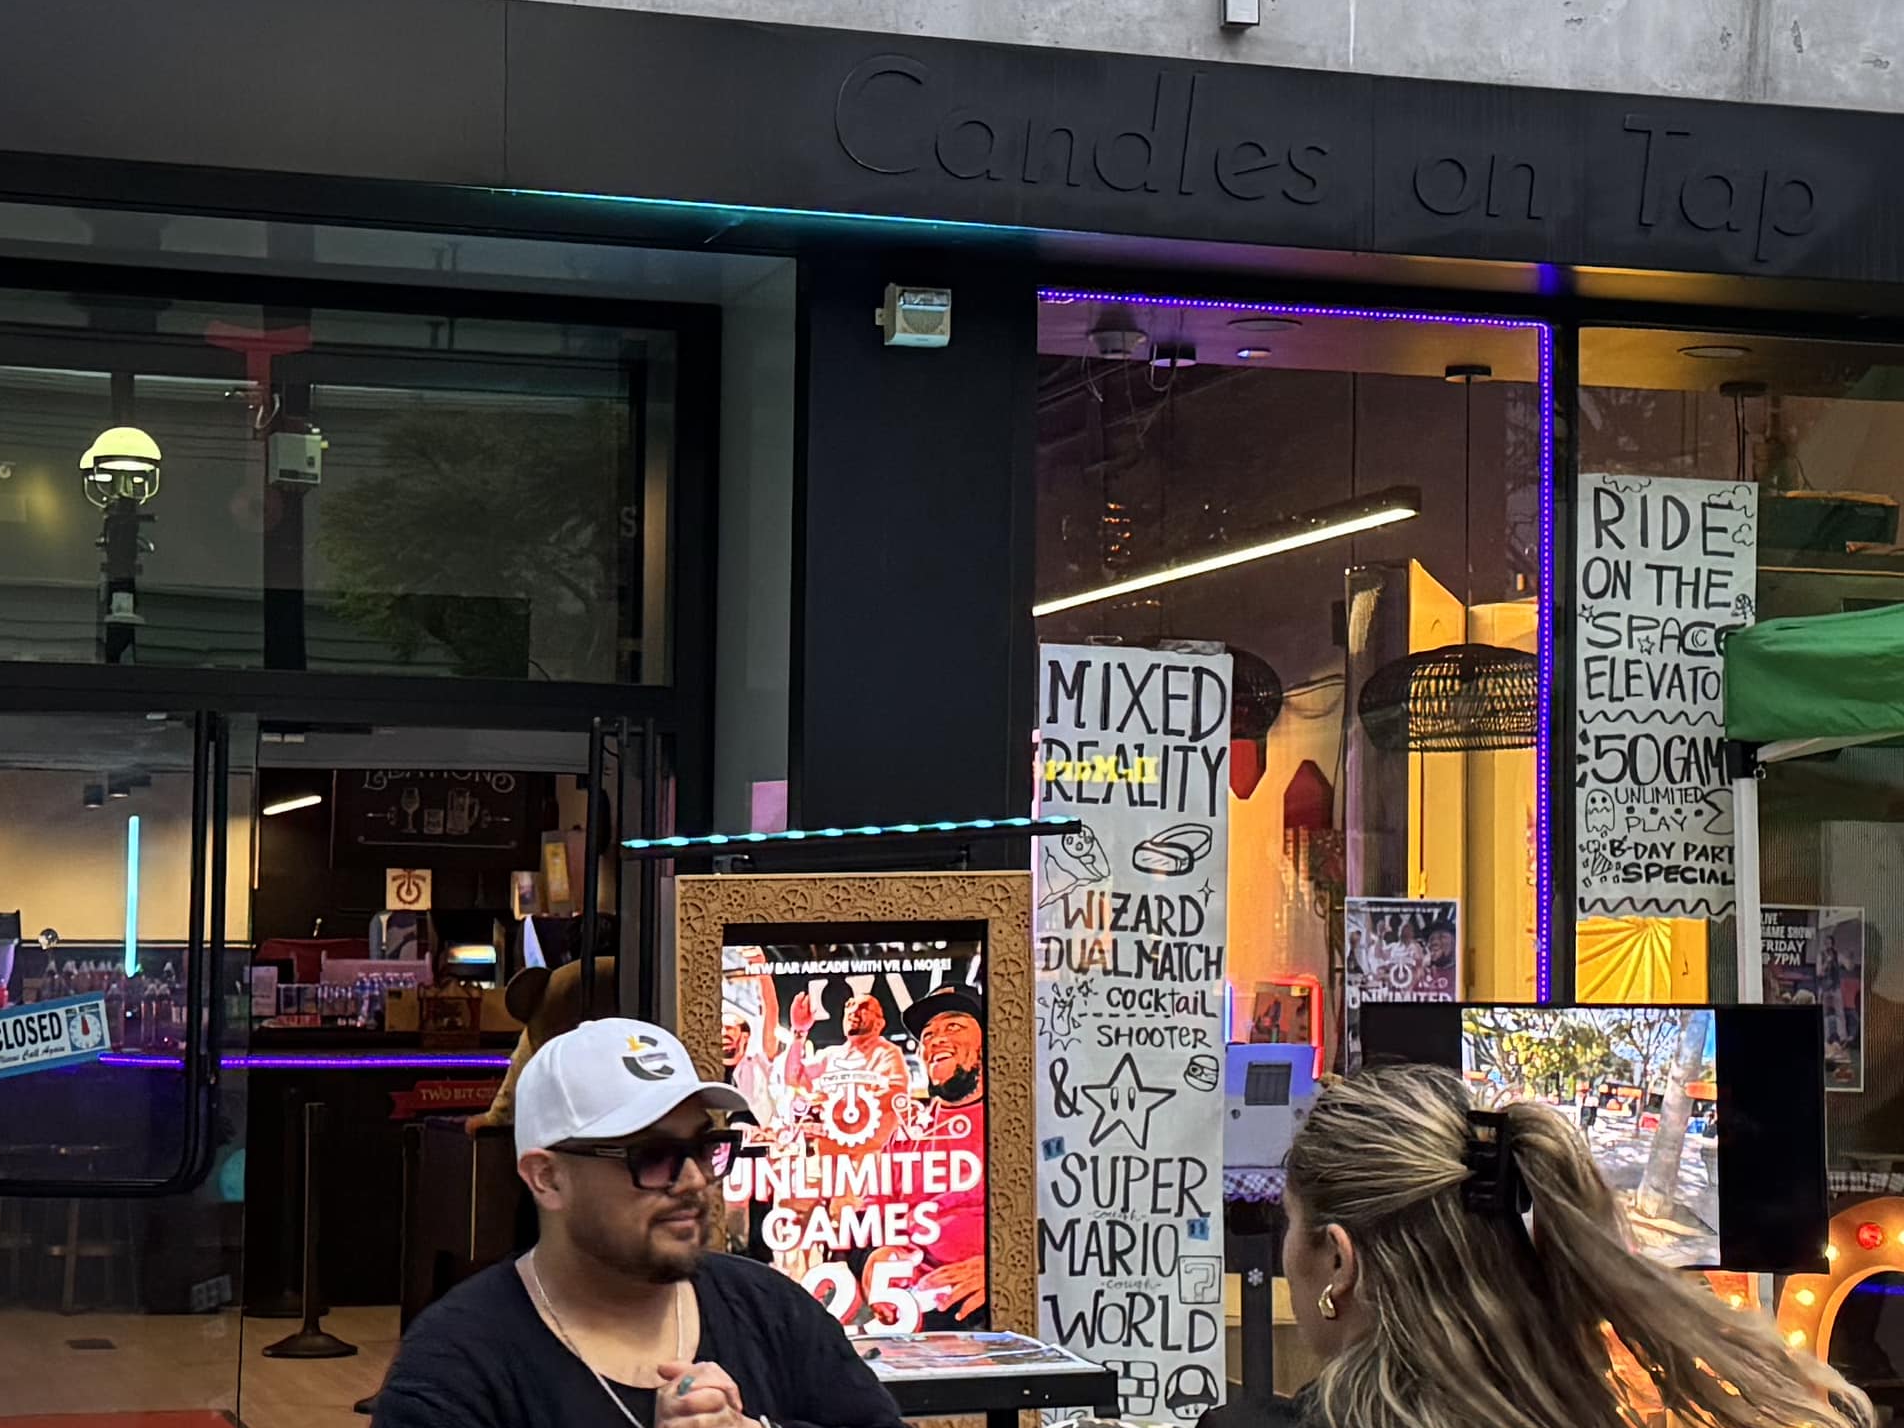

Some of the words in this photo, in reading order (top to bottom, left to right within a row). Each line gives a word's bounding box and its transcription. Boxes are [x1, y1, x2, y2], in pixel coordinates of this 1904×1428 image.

[833, 52, 1325, 206] Candles
[1411, 155, 1544, 222] on
[1622, 112, 1817, 263] Tap
[1593, 486, 1735, 559] RIDE
[1582, 556, 1633, 601] ON
[1644, 563, 1734, 609] THE
[1585, 610, 1736, 658] SPAC
[1046, 659, 1228, 743] MIXED
[1041, 737, 1228, 817] REALITY
[1614, 785, 1704, 805] UNLIMITED
[1626, 814, 1688, 833] PLAY
[1622, 863, 1735, 886] SPECIAL
[1059, 889, 1206, 938] WIZARD
[776, 961, 800, 975] BAR
[801, 960, 849, 974] ARCADE
[851, 959, 882, 973] WITH
[883, 959, 901, 972] VR
[1774, 953, 1801, 966] 7PM
[420, 1085, 452, 1101] TWO
[723, 1149, 982, 1204] UNLIMITED
[1051, 1152, 1211, 1219] SUPER
[762, 1201, 942, 1251] GAMES
[1038, 1217, 1179, 1278] MARIO
[1043, 1290, 1218, 1353] WORLD
